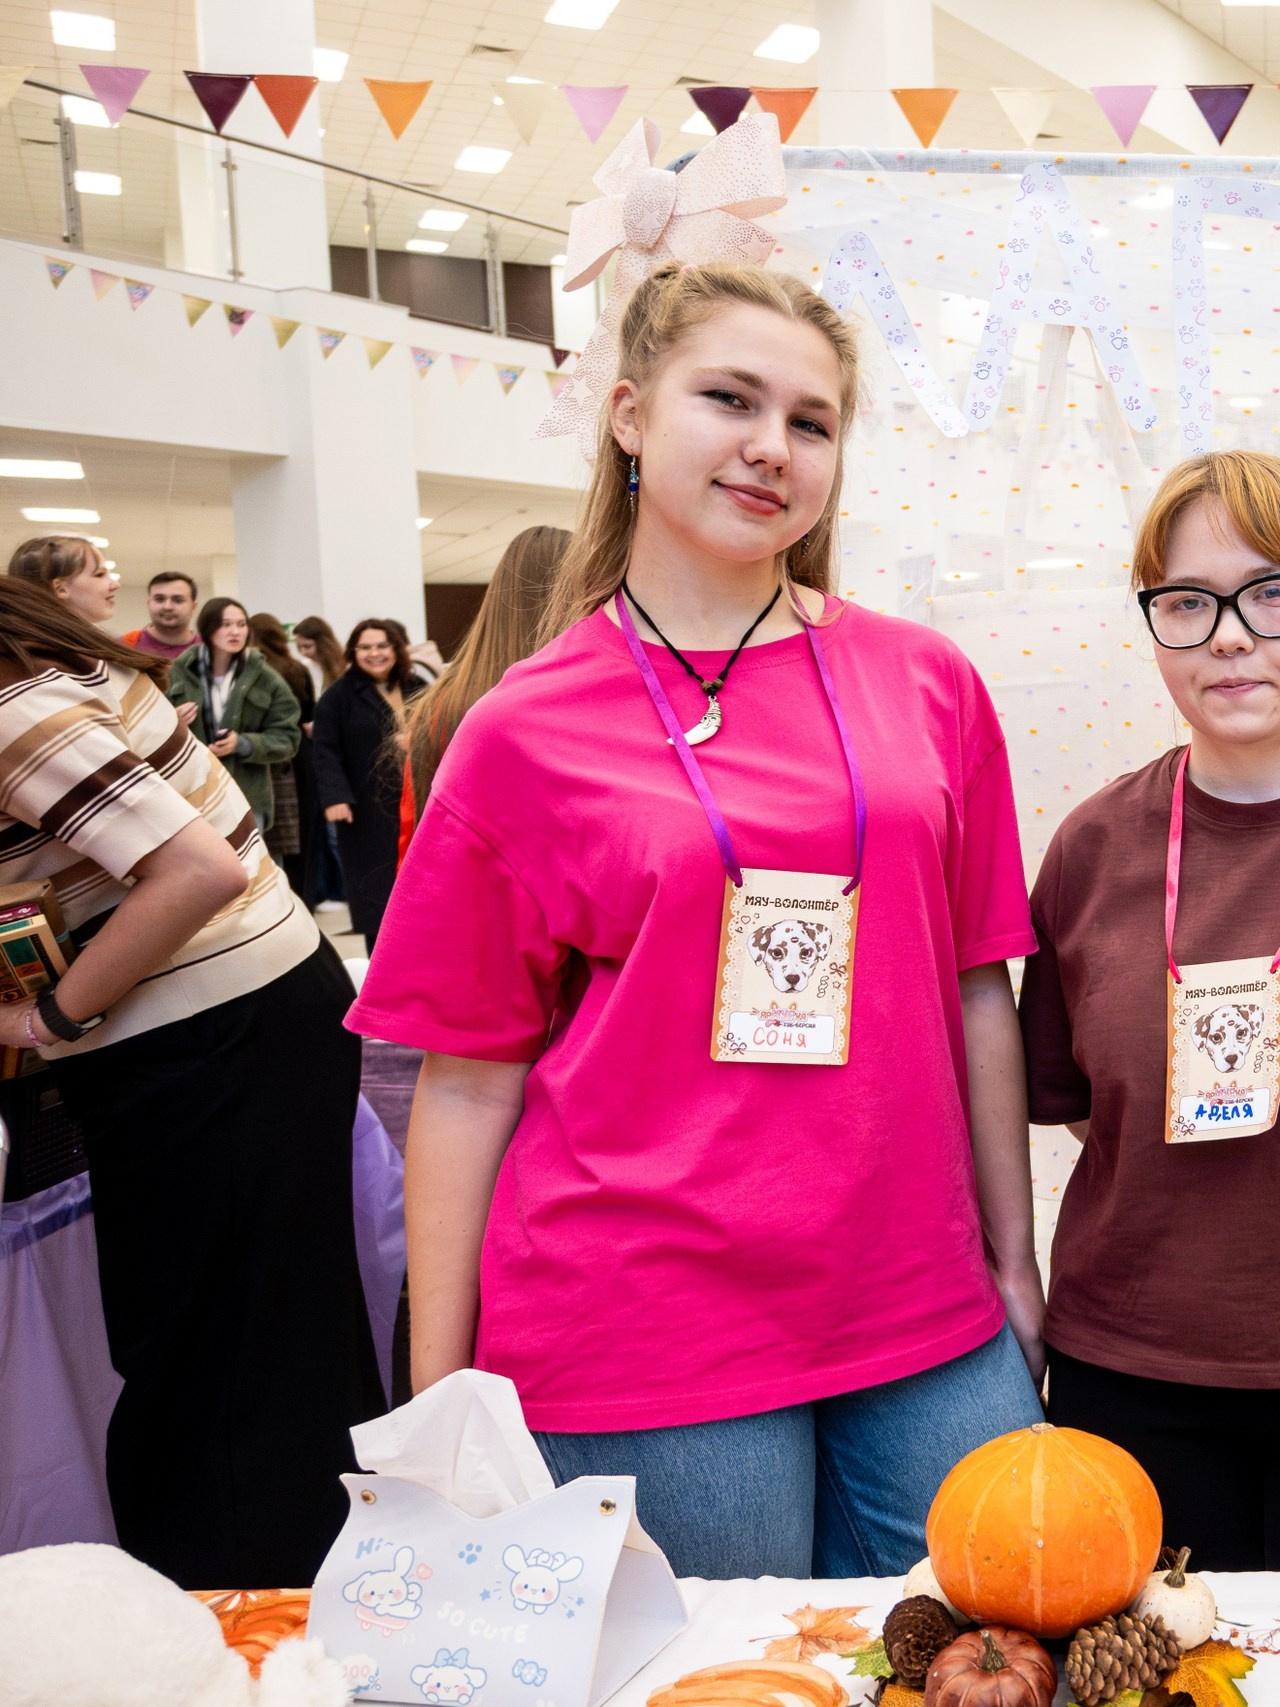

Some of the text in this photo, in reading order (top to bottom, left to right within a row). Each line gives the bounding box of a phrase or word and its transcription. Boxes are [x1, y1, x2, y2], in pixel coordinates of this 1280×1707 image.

[744, 895, 839, 912] МЯУ-ВОЛОНТЁР
[1185, 981, 1268, 1000] МЯУ-ВОЛОНТЁР
[752, 1026, 807, 1048] СОНЯ
[1194, 1103, 1254, 1122] АДЕЛЯ
[469, 1616, 529, 1643] CUTE
